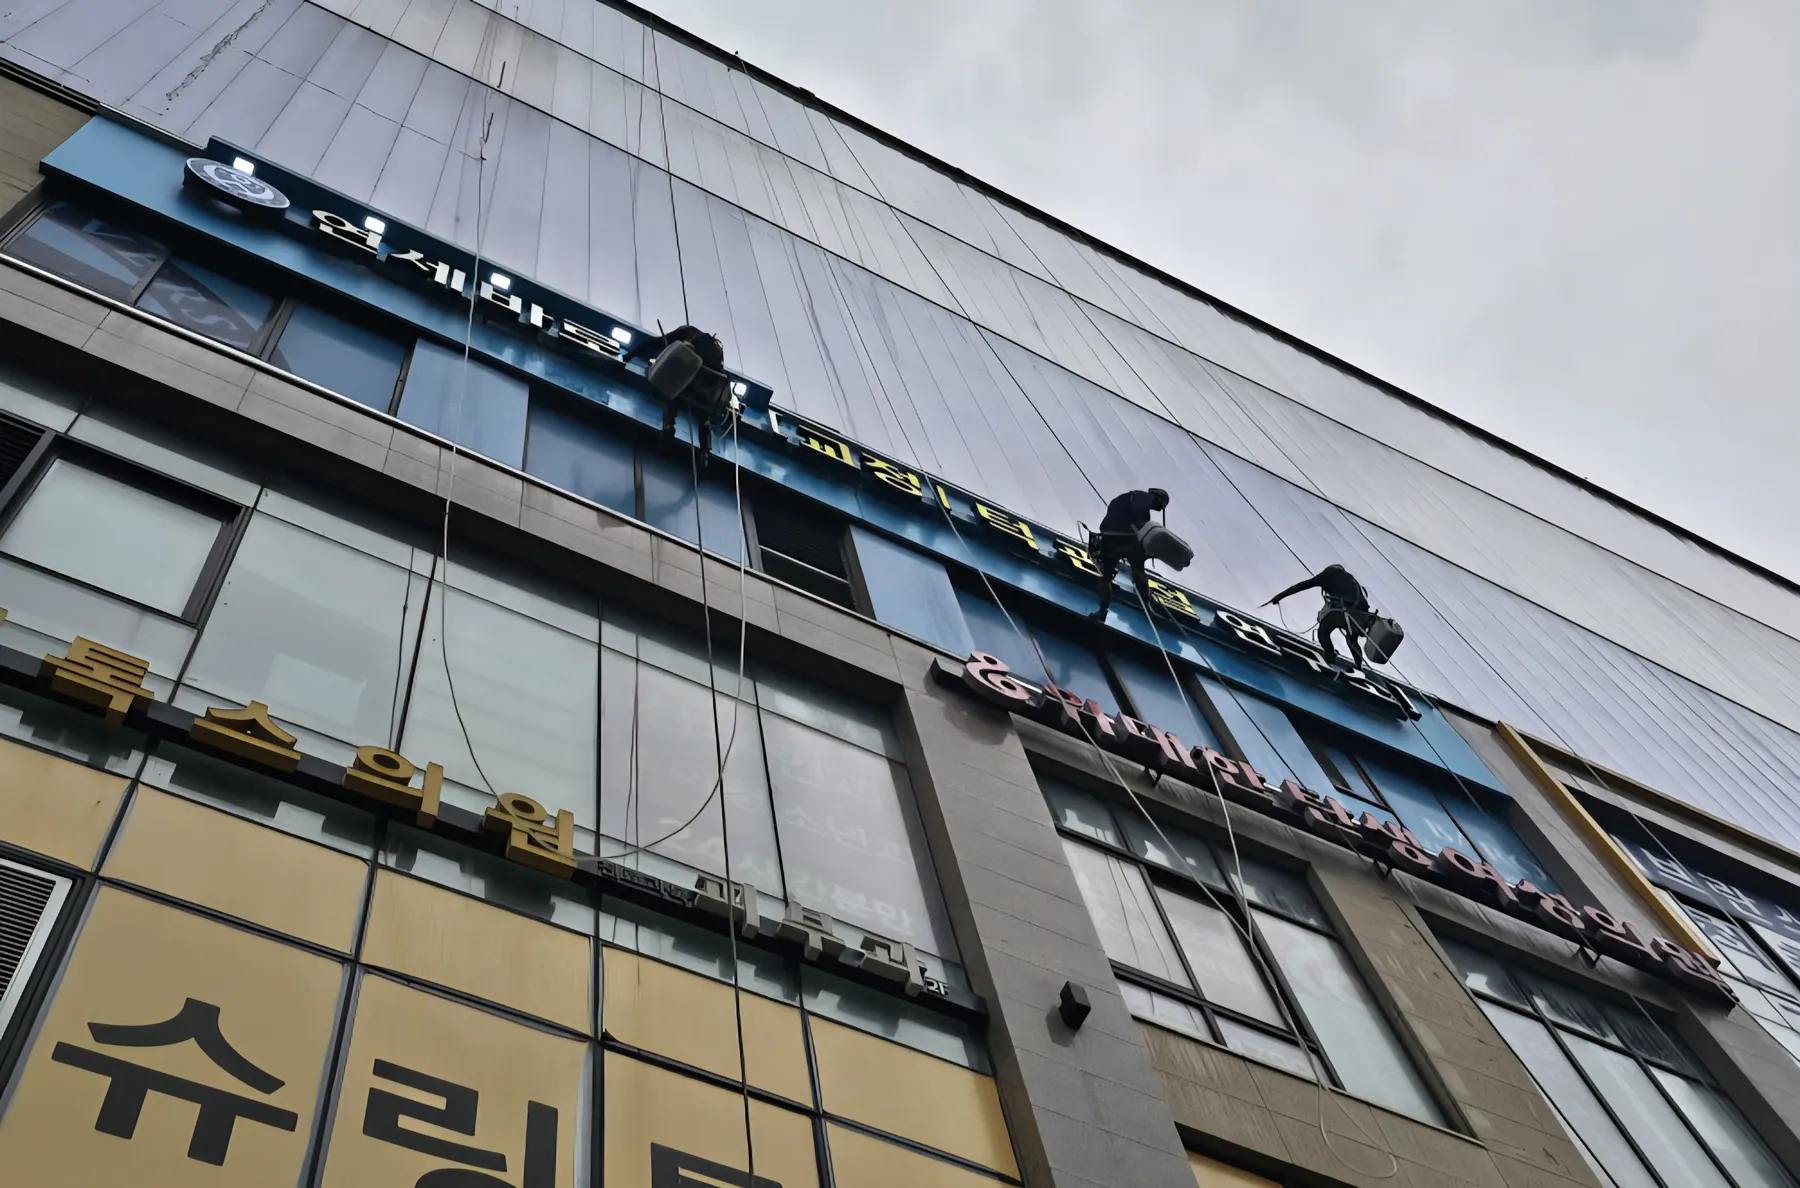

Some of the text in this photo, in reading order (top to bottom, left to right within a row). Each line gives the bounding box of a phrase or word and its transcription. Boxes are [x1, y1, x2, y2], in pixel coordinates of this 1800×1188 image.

[0, 606, 577, 879] 톡스의원
[694, 863, 928, 999] 피부과
[51, 997, 784, 1188] 슈링
